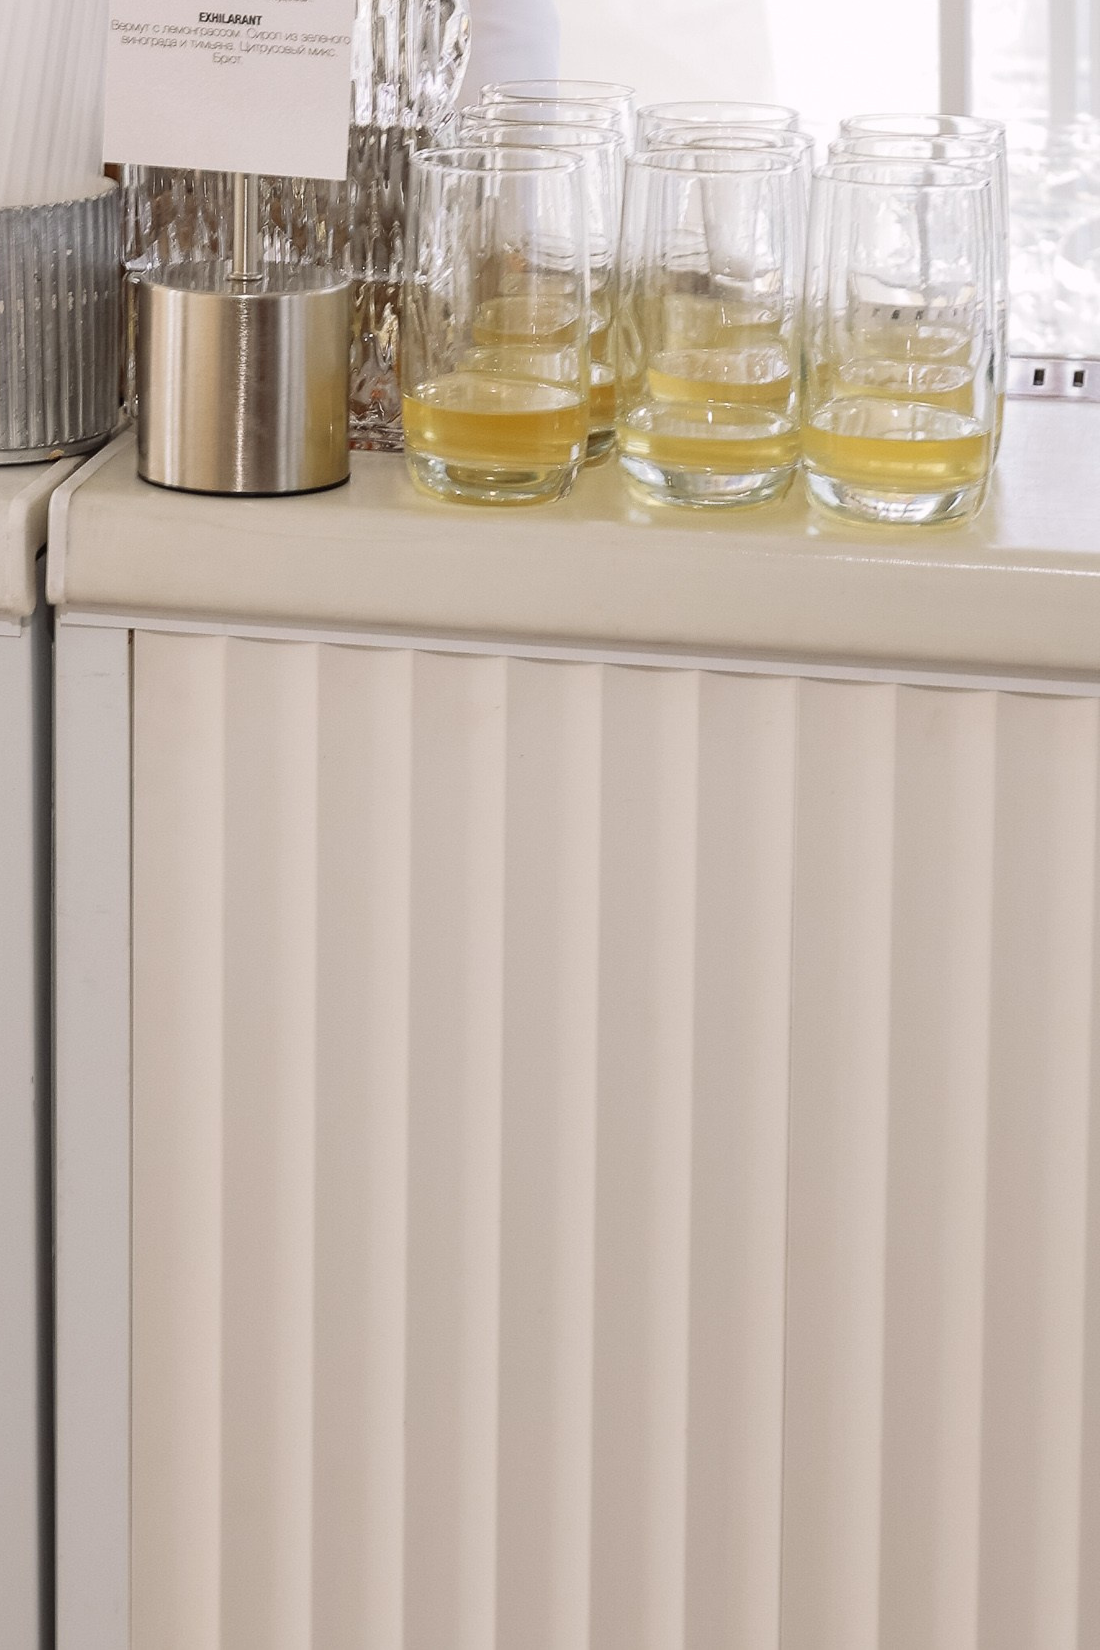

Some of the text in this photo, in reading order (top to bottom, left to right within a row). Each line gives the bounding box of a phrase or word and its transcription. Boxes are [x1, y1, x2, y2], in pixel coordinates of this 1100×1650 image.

[199, 12, 262, 25] EXHILARANT
[111, 20, 150, 33] Вермут
[152, 25, 160, 33] с
[246, 28, 282, 41] Сироп
[285, 32, 298, 41] из
[301, 33, 350, 45] зеленого
[121, 36, 177, 47] винограда
[180, 39, 187, 47] и
[240, 41, 305, 55] Цитрусовый
